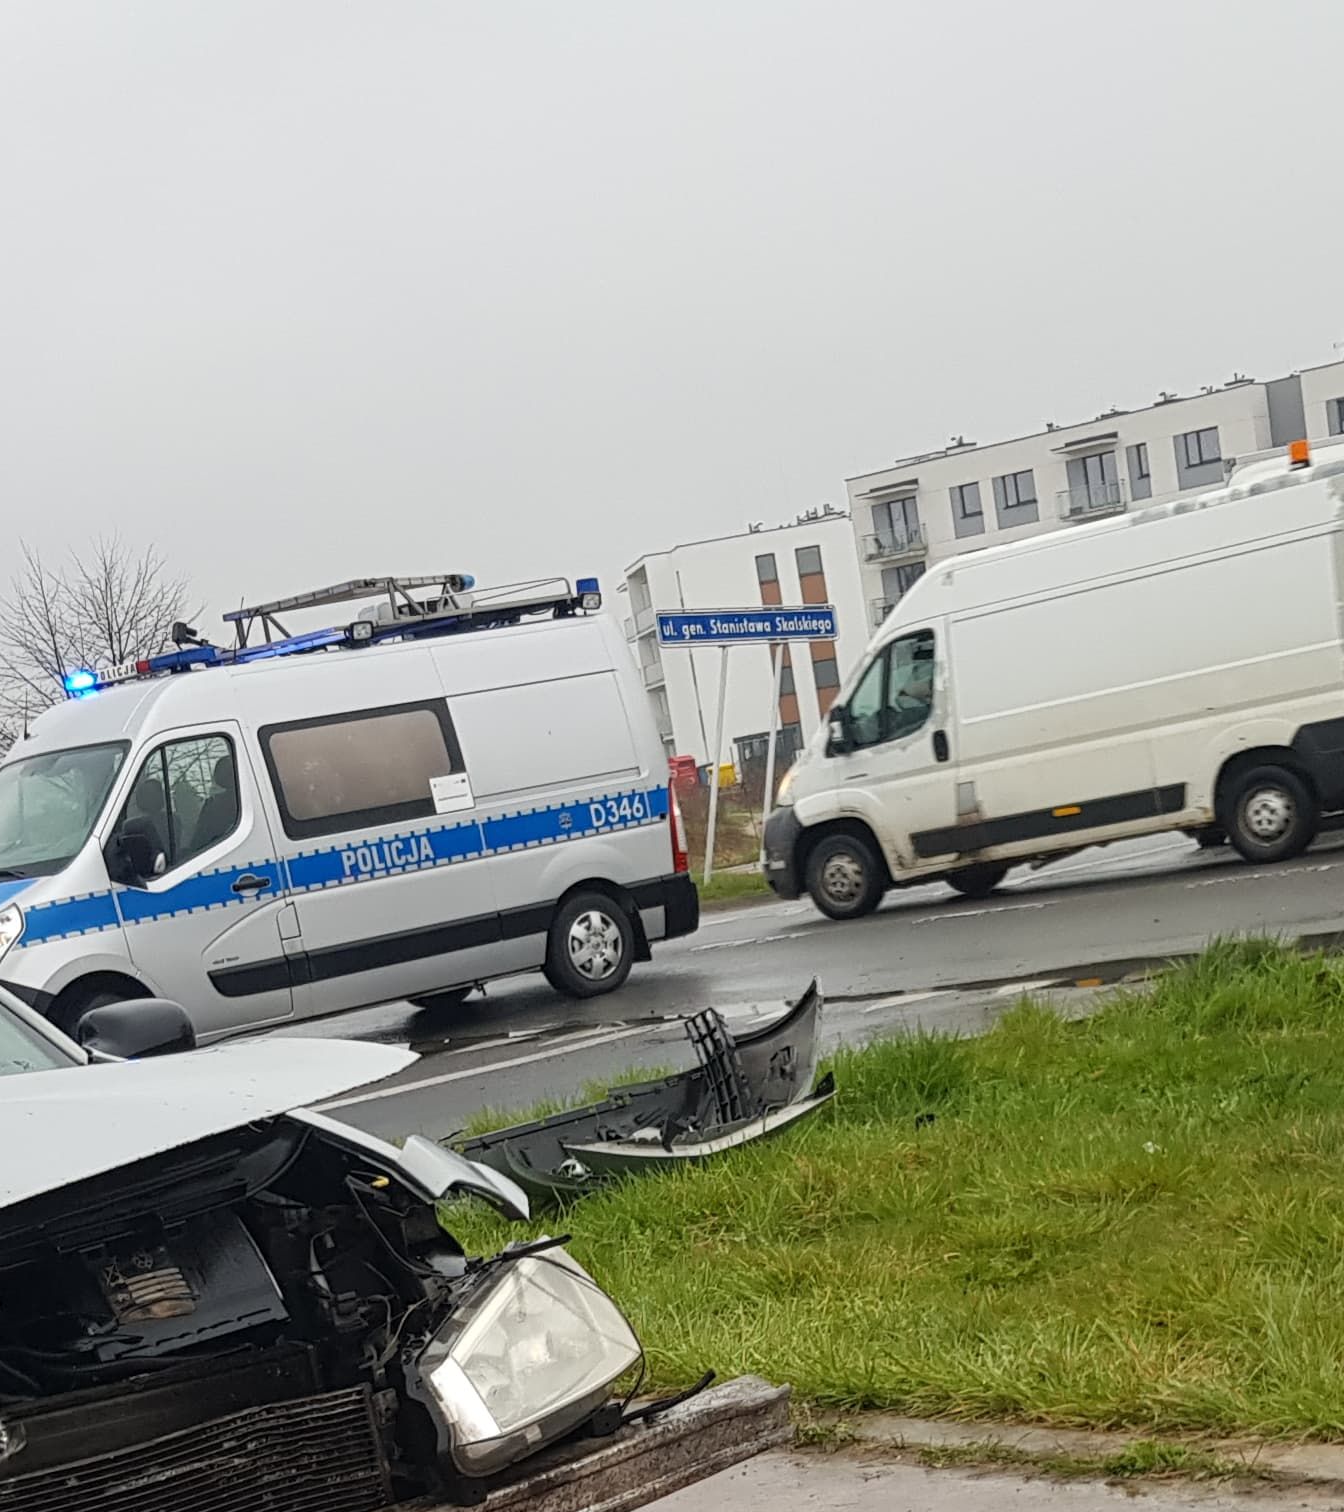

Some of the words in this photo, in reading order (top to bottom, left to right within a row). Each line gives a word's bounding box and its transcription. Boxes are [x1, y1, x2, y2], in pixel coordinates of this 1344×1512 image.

[663, 621, 678, 636] ul.
[681, 623, 705, 639] gen.
[709, 617, 771, 634] Stanisława
[776, 616, 832, 634] Skalskiego
[100, 663, 136, 681] OLICJA
[589, 794, 644, 828] D346
[340, 836, 436, 876] POLICJA
